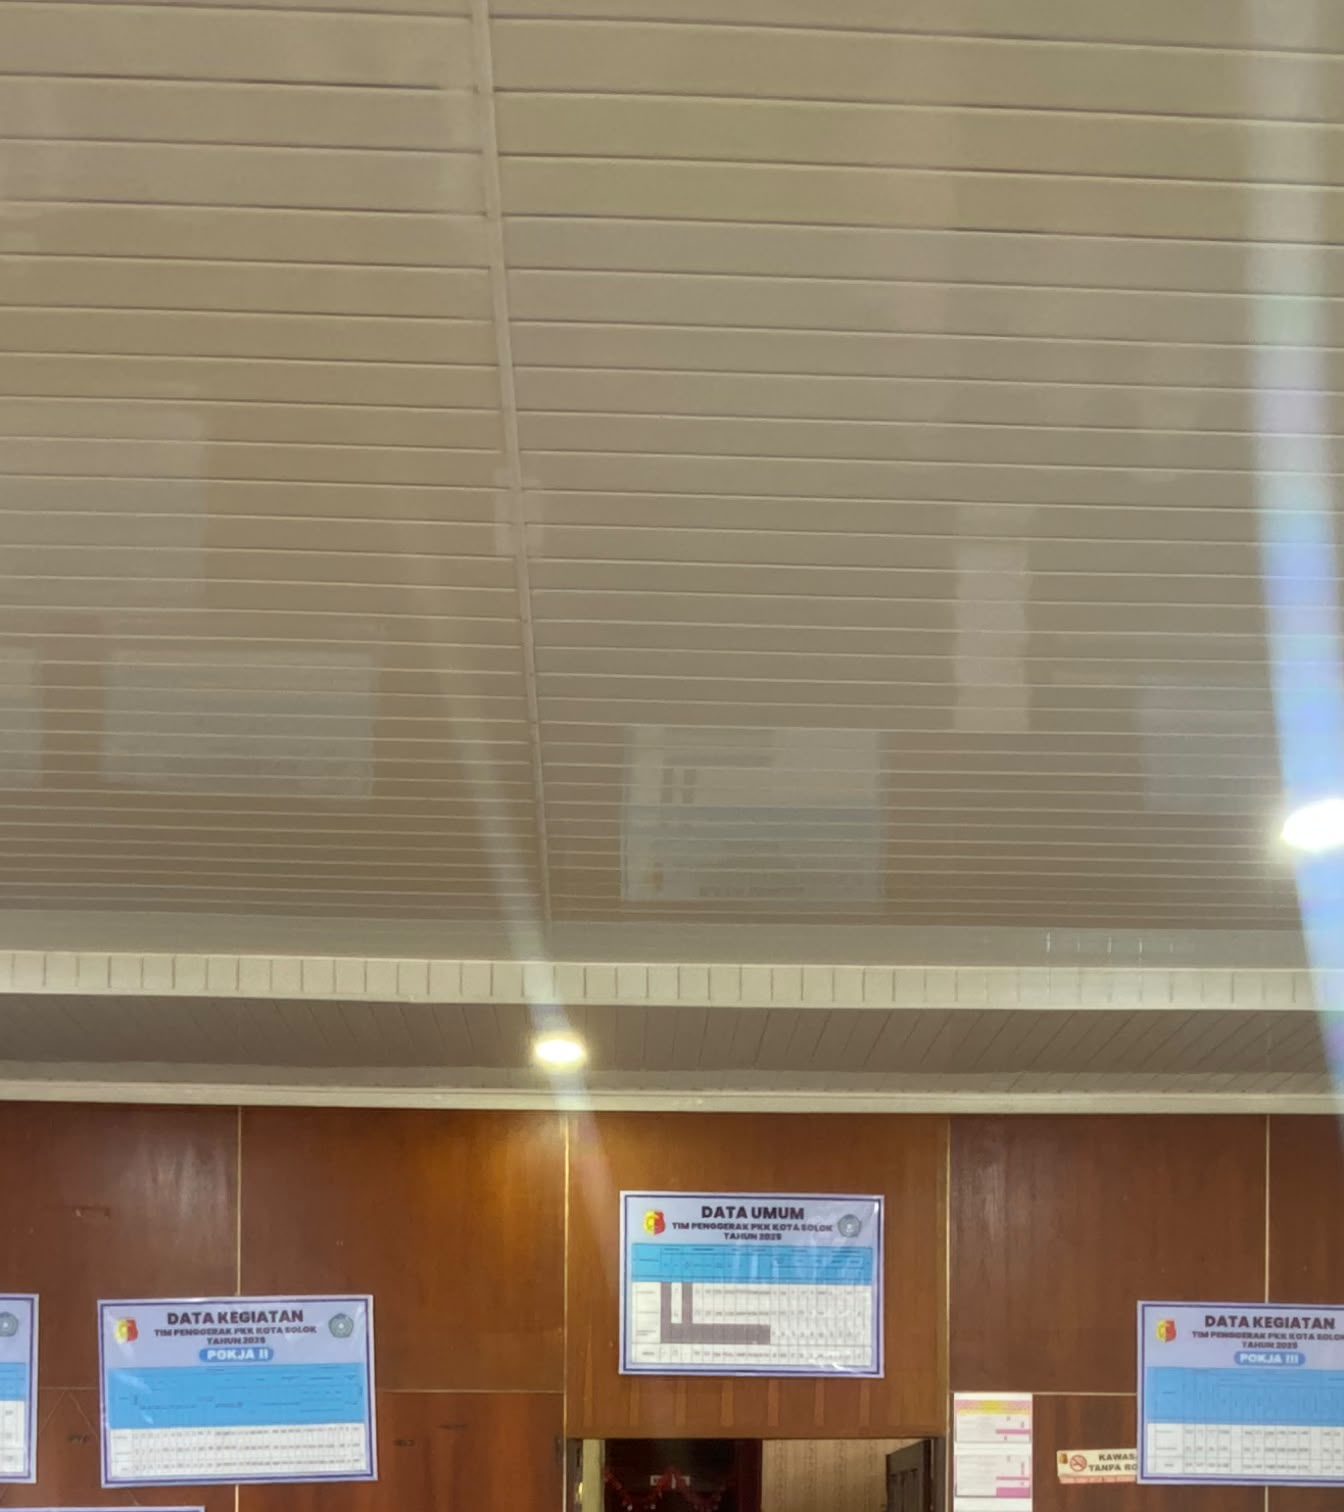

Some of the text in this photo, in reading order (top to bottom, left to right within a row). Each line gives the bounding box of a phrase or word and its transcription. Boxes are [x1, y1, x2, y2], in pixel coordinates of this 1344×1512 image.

[702, 1206, 804, 1219] DATA UMUM
[801, 1224, 832, 1232] SOLOK
[167, 1310, 303, 1325] DATA KEGIATAN
[1205, 1315, 1335, 1329] DATA KEGIATAN
[174, 1328, 231, 1336] PENGGERAK
[234, 1327, 254, 1335] PKK
[285, 1326, 317, 1334] SOLOK
[1268, 1332, 1287, 1340] PKK
[208, 1337, 241, 1345] TAHUN
[207, 1349, 268, 1360] POKJA II
[1240, 1354, 1298, 1363] POKJA III
